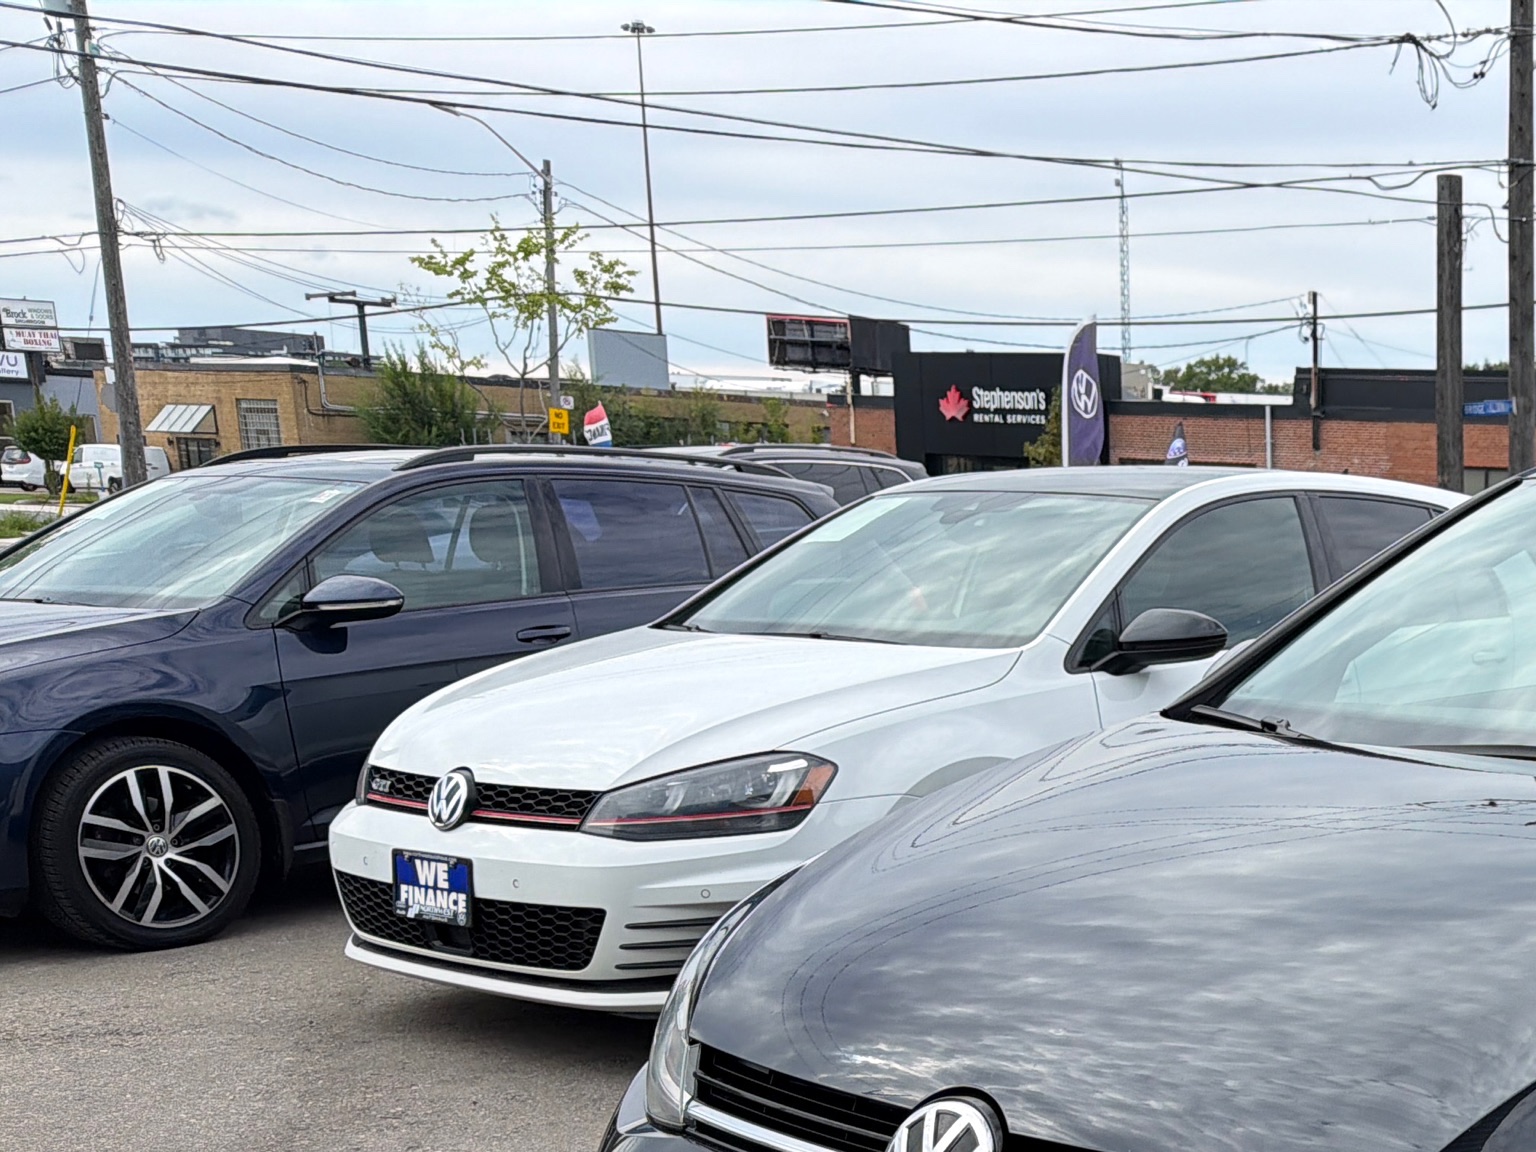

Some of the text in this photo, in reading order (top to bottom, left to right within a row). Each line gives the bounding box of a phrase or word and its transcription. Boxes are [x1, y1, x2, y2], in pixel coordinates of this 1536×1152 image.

[15, 330, 36, 338] MUAY
[24, 338, 52, 346] BOXING
[972, 386, 1046, 411] Stephenson's
[973, 413, 1046, 424] RENTAL SERVICES
[428, 773, 468, 830] VW
[414, 859, 450, 889] WE
[400, 884, 467, 913] FINANCE
